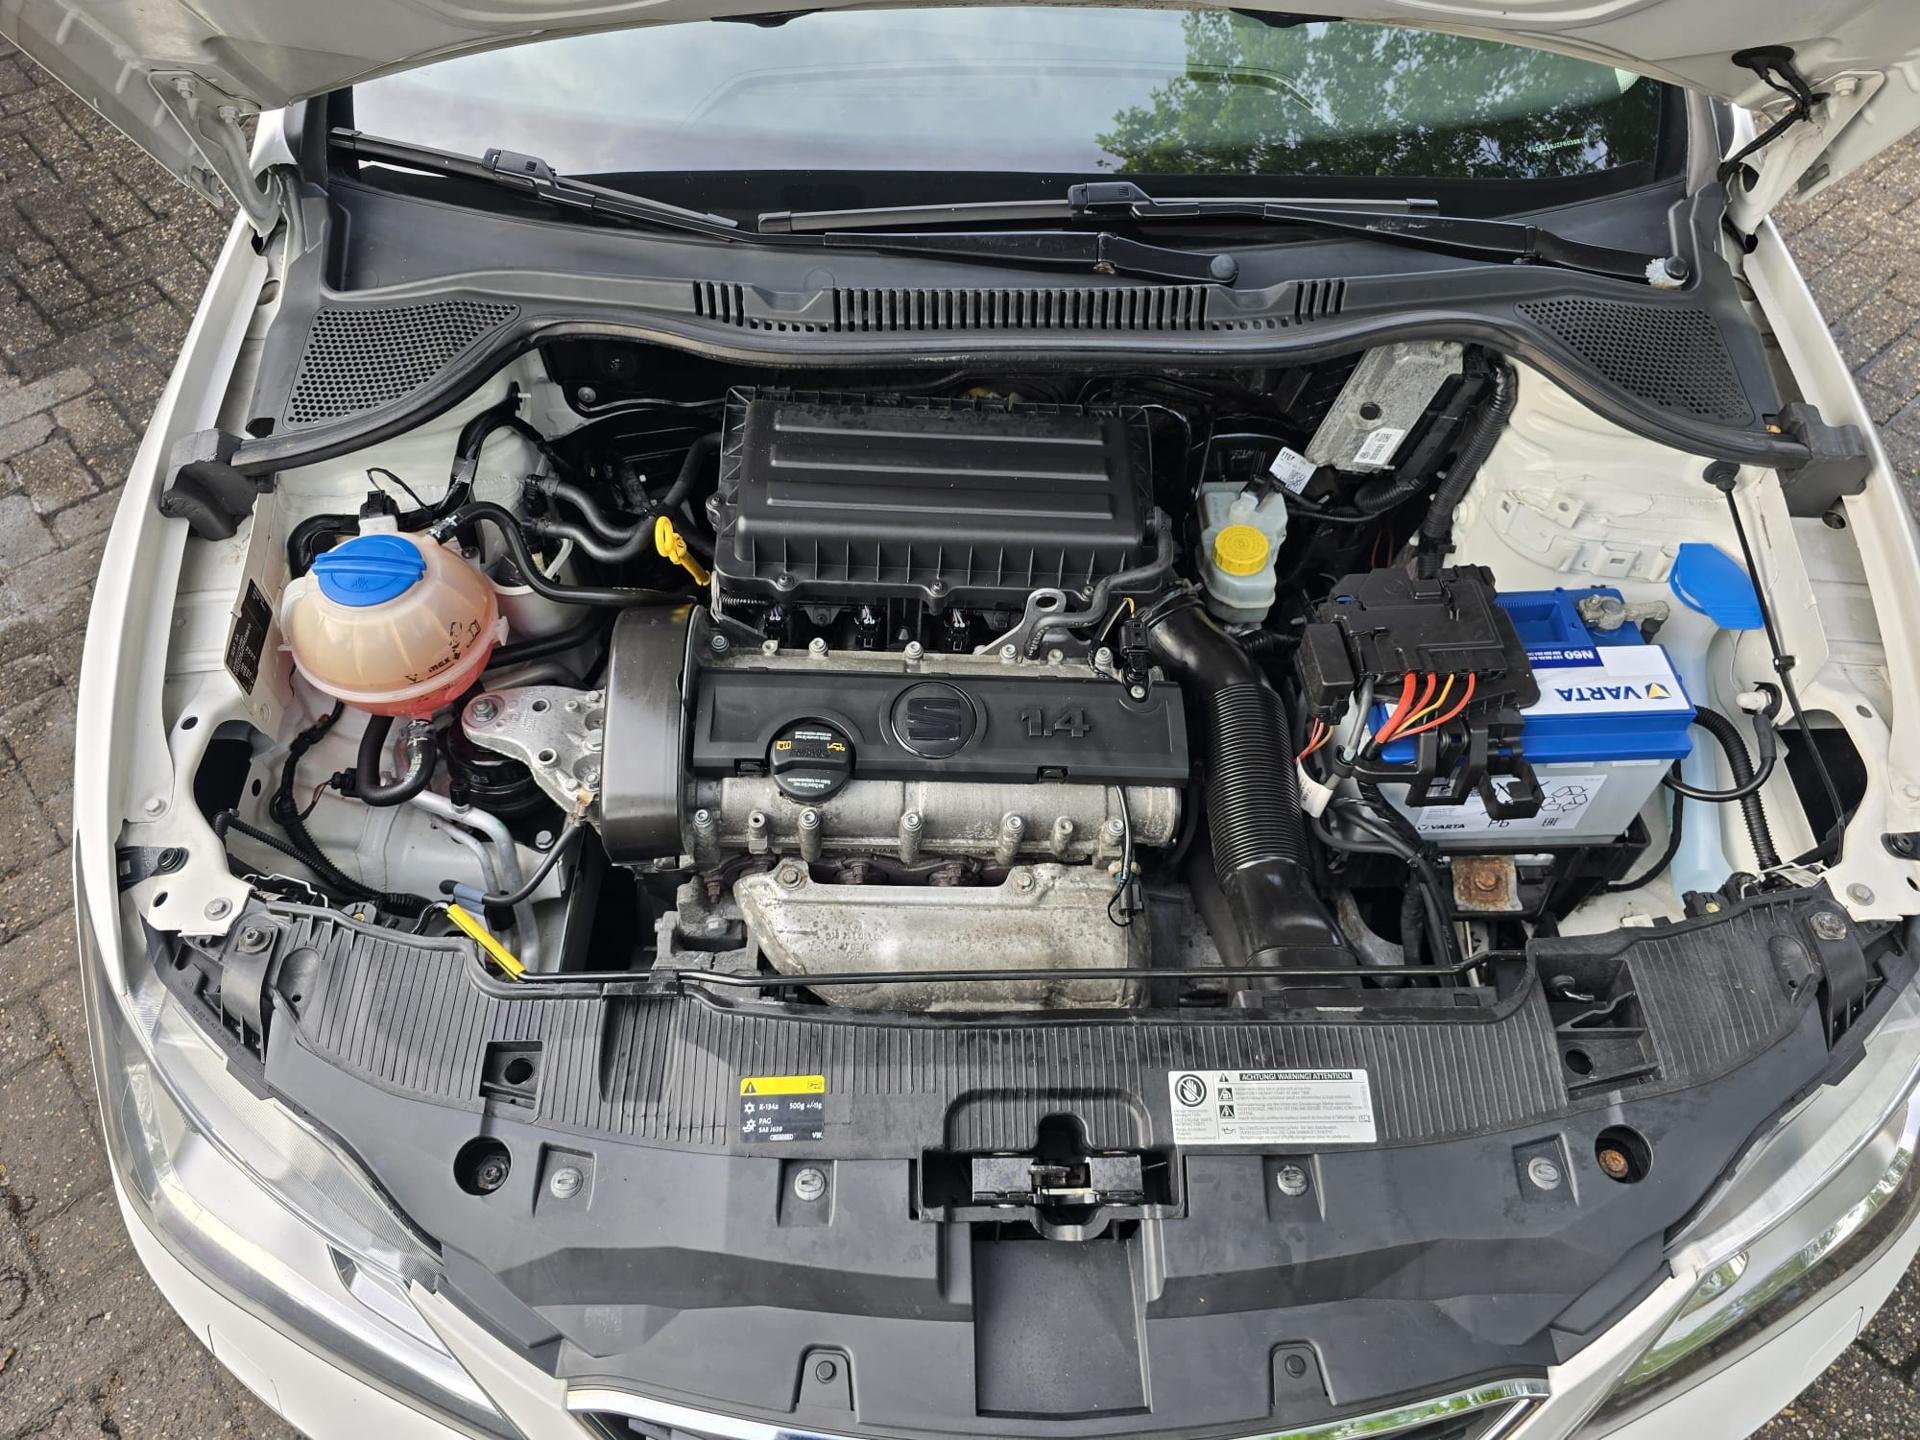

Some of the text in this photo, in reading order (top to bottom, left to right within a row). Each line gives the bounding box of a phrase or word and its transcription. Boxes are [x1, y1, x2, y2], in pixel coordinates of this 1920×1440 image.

[1563, 650, 1594, 660] N60
[1554, 686, 1643, 702] VARTA
[1020, 708, 1090, 738] 1.4
[1241, 1072, 1351, 1081] ACHTUNG! WARNING! ATTENTION!
